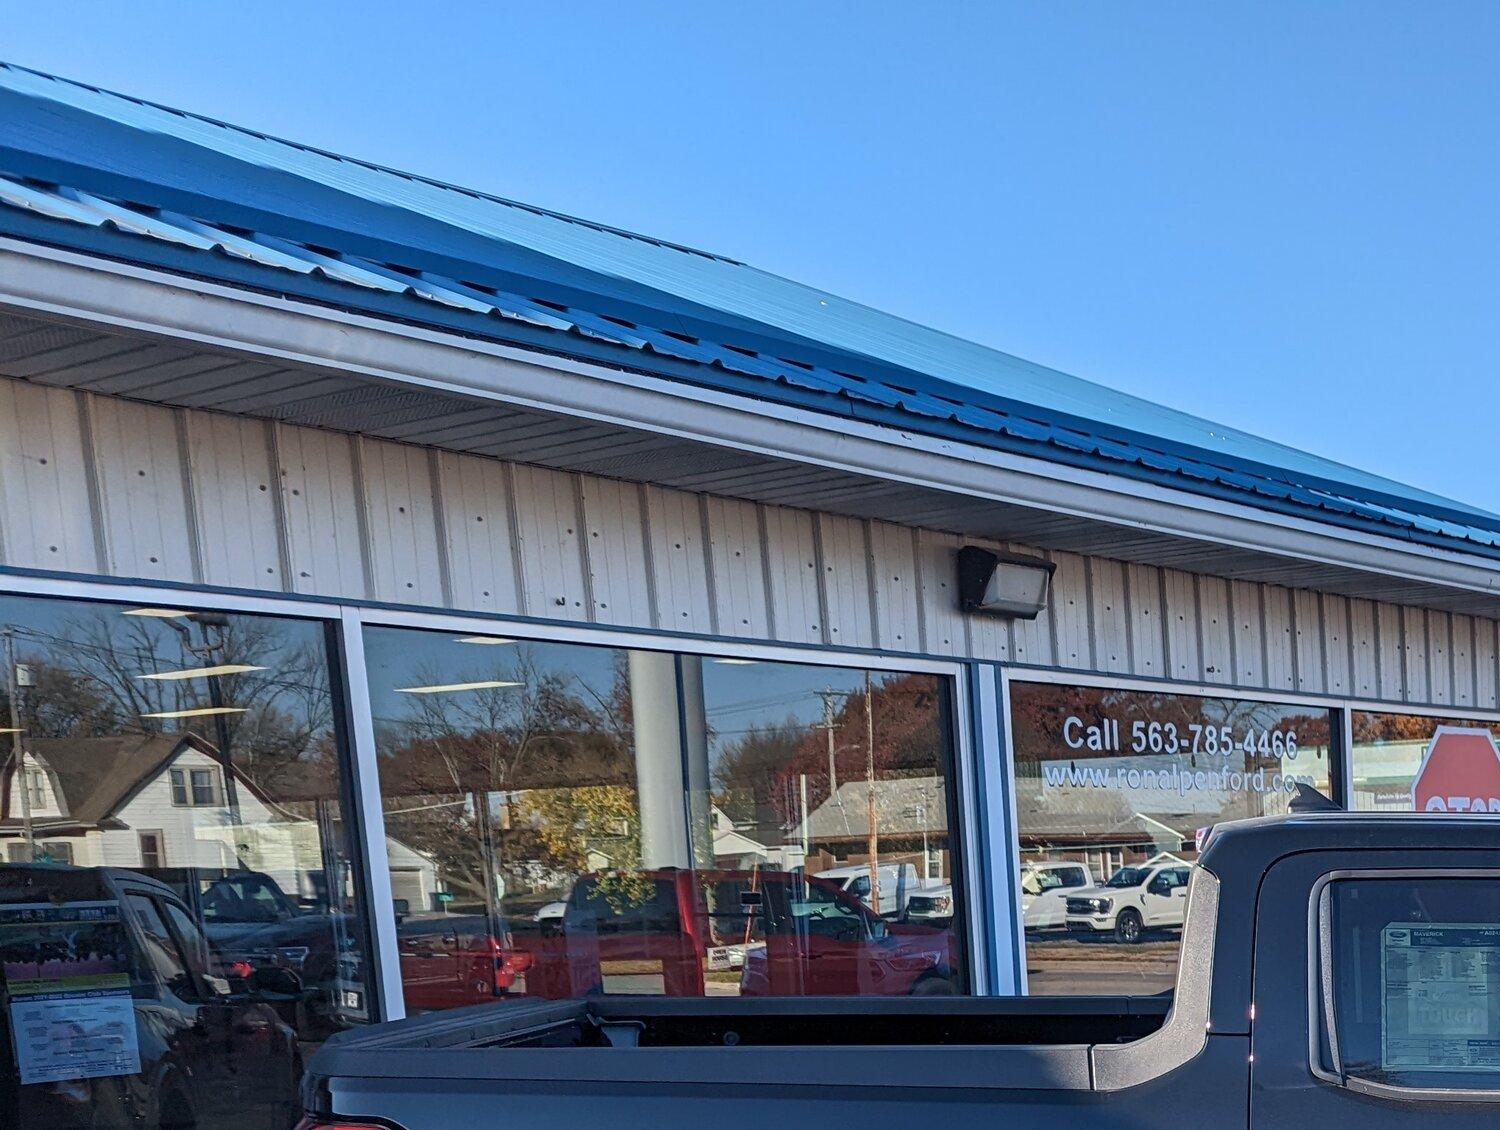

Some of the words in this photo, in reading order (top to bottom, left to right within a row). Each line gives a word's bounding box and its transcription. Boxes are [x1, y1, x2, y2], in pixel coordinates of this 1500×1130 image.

[1063, 716, 1119, 751] Call
[1131, 720, 1298, 760] 563-785-4466
[1044, 764, 1314, 796] wwwronalpenford.com
